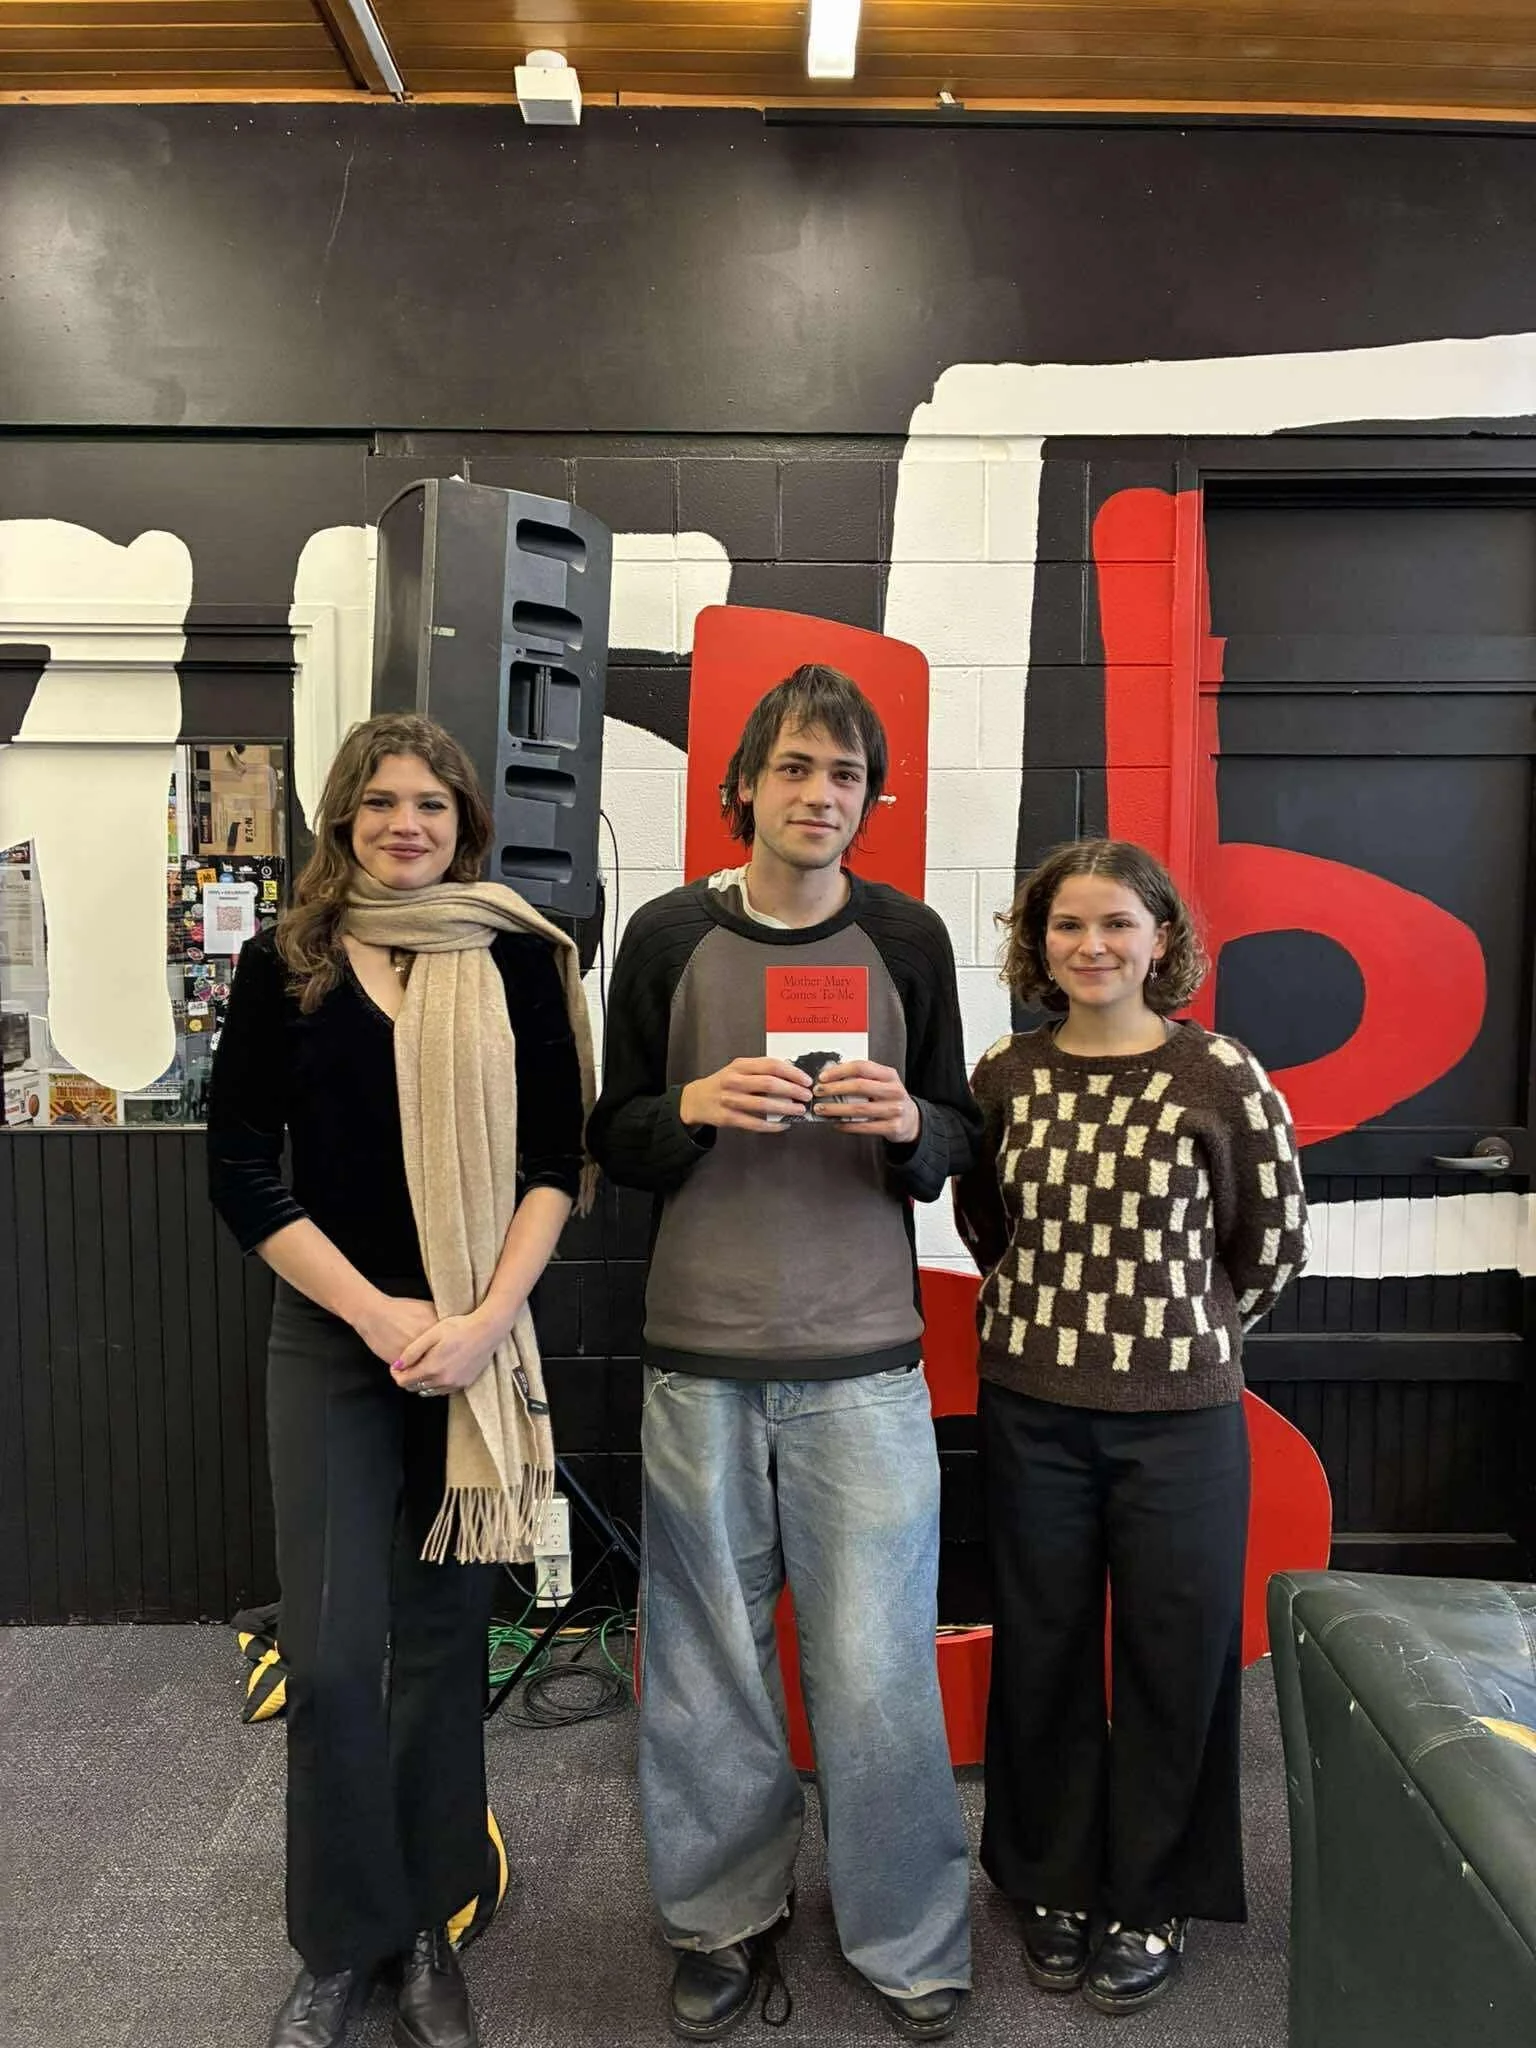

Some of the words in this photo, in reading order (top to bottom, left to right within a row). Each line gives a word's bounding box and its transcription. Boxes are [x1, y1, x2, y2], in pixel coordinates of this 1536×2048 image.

[783, 975, 821, 987] Mother
[824, 975, 852, 988] Mary
[780, 988, 816, 1000] Comes
[819, 988, 834, 1000] To
[838, 988, 855, 1000] Me
[831, 1014, 849, 1025] Roy
